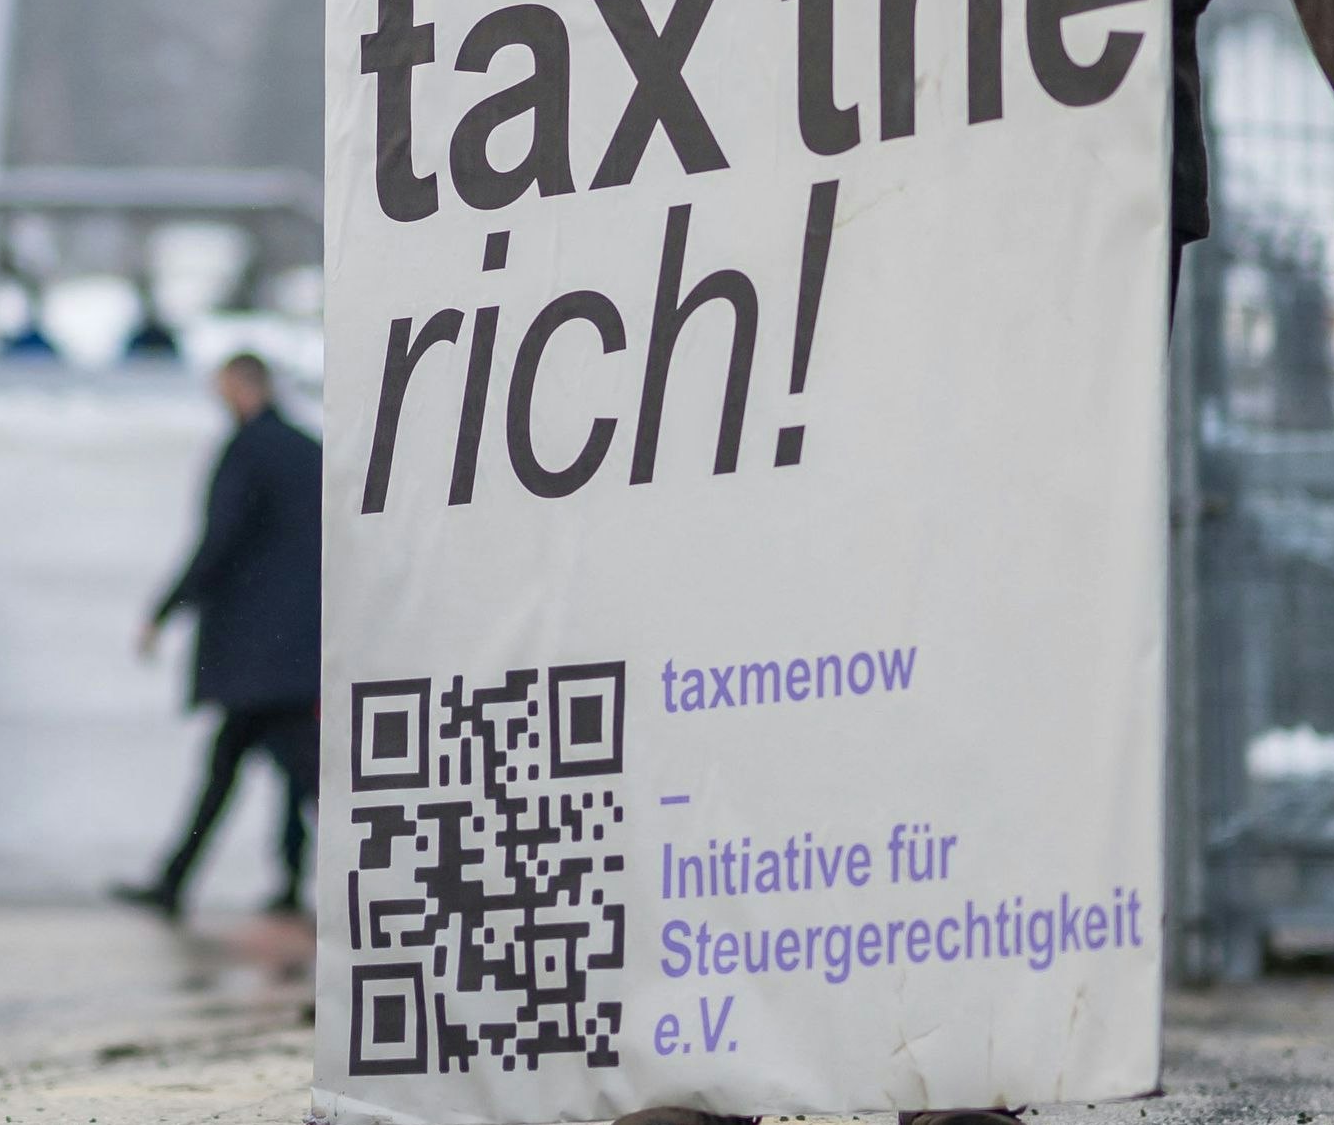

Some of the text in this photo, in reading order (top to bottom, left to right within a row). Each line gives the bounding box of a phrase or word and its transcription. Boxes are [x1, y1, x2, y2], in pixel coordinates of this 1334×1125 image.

[361, 180, 839, 514] rich!
[661, 648, 918, 713] taxmenow
[661, 824, 957, 899] Initiative für
[660, 888, 1143, 984] Steuergerechtigkeit
[653, 996, 738, 1057] e.V.
